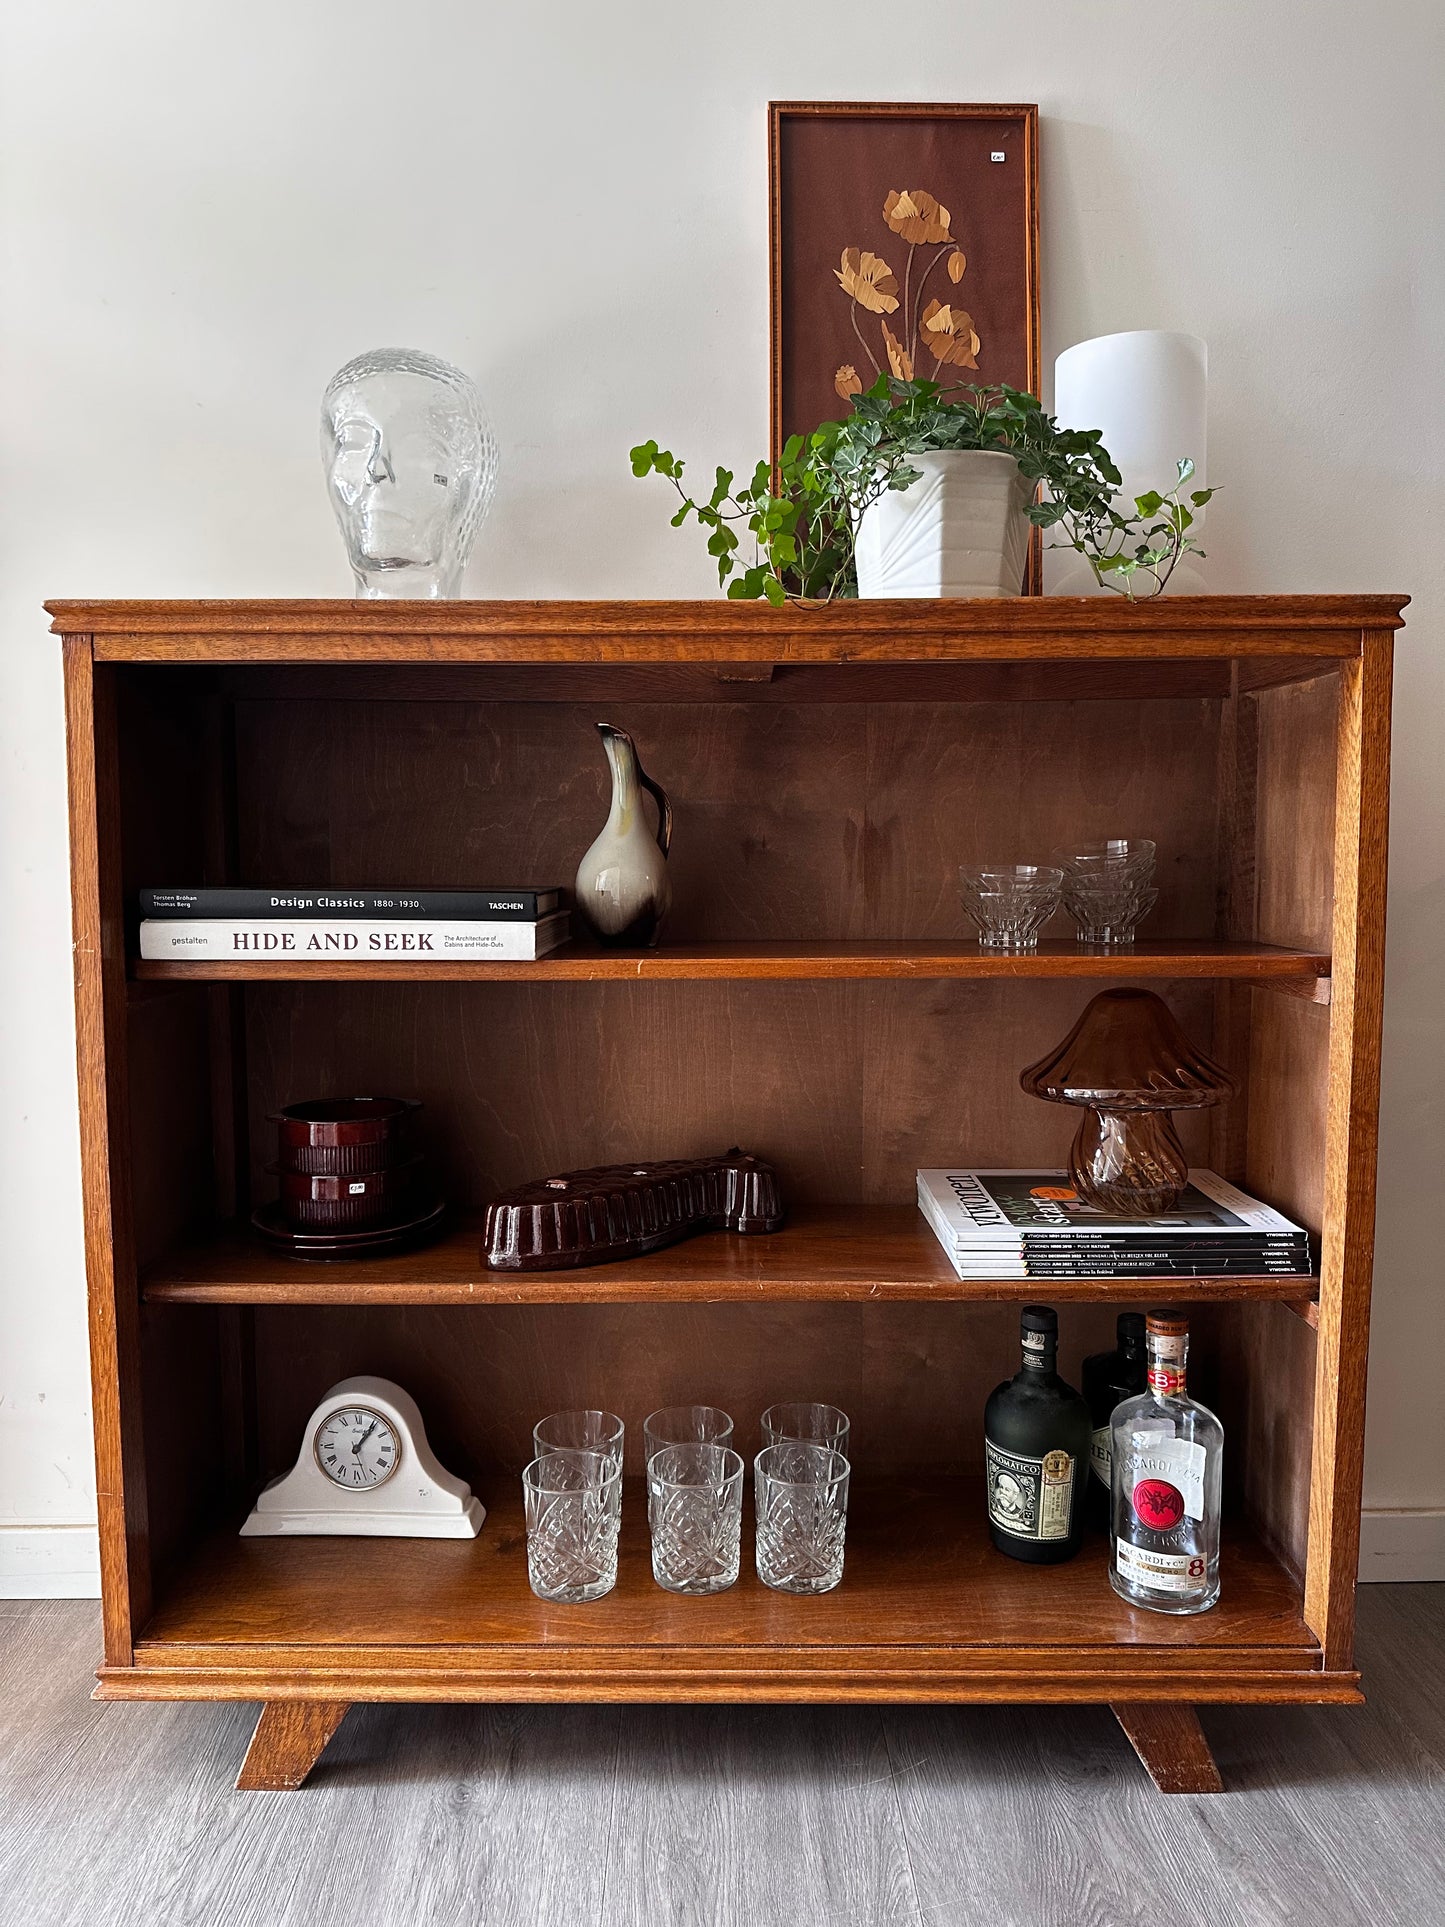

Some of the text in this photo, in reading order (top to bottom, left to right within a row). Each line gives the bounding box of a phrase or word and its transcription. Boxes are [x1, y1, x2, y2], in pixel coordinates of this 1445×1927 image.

[270, 897, 313, 909] Design
[317, 898, 365, 908] Classics
[488, 902, 524, 910] TASCHEN
[171, 937, 208, 946] gestalten
[232, 933, 435, 951] HIDE AND SEEK
[1118, 1542, 1164, 1567] BACARDI
[1188, 1558, 1205, 1577] 8
